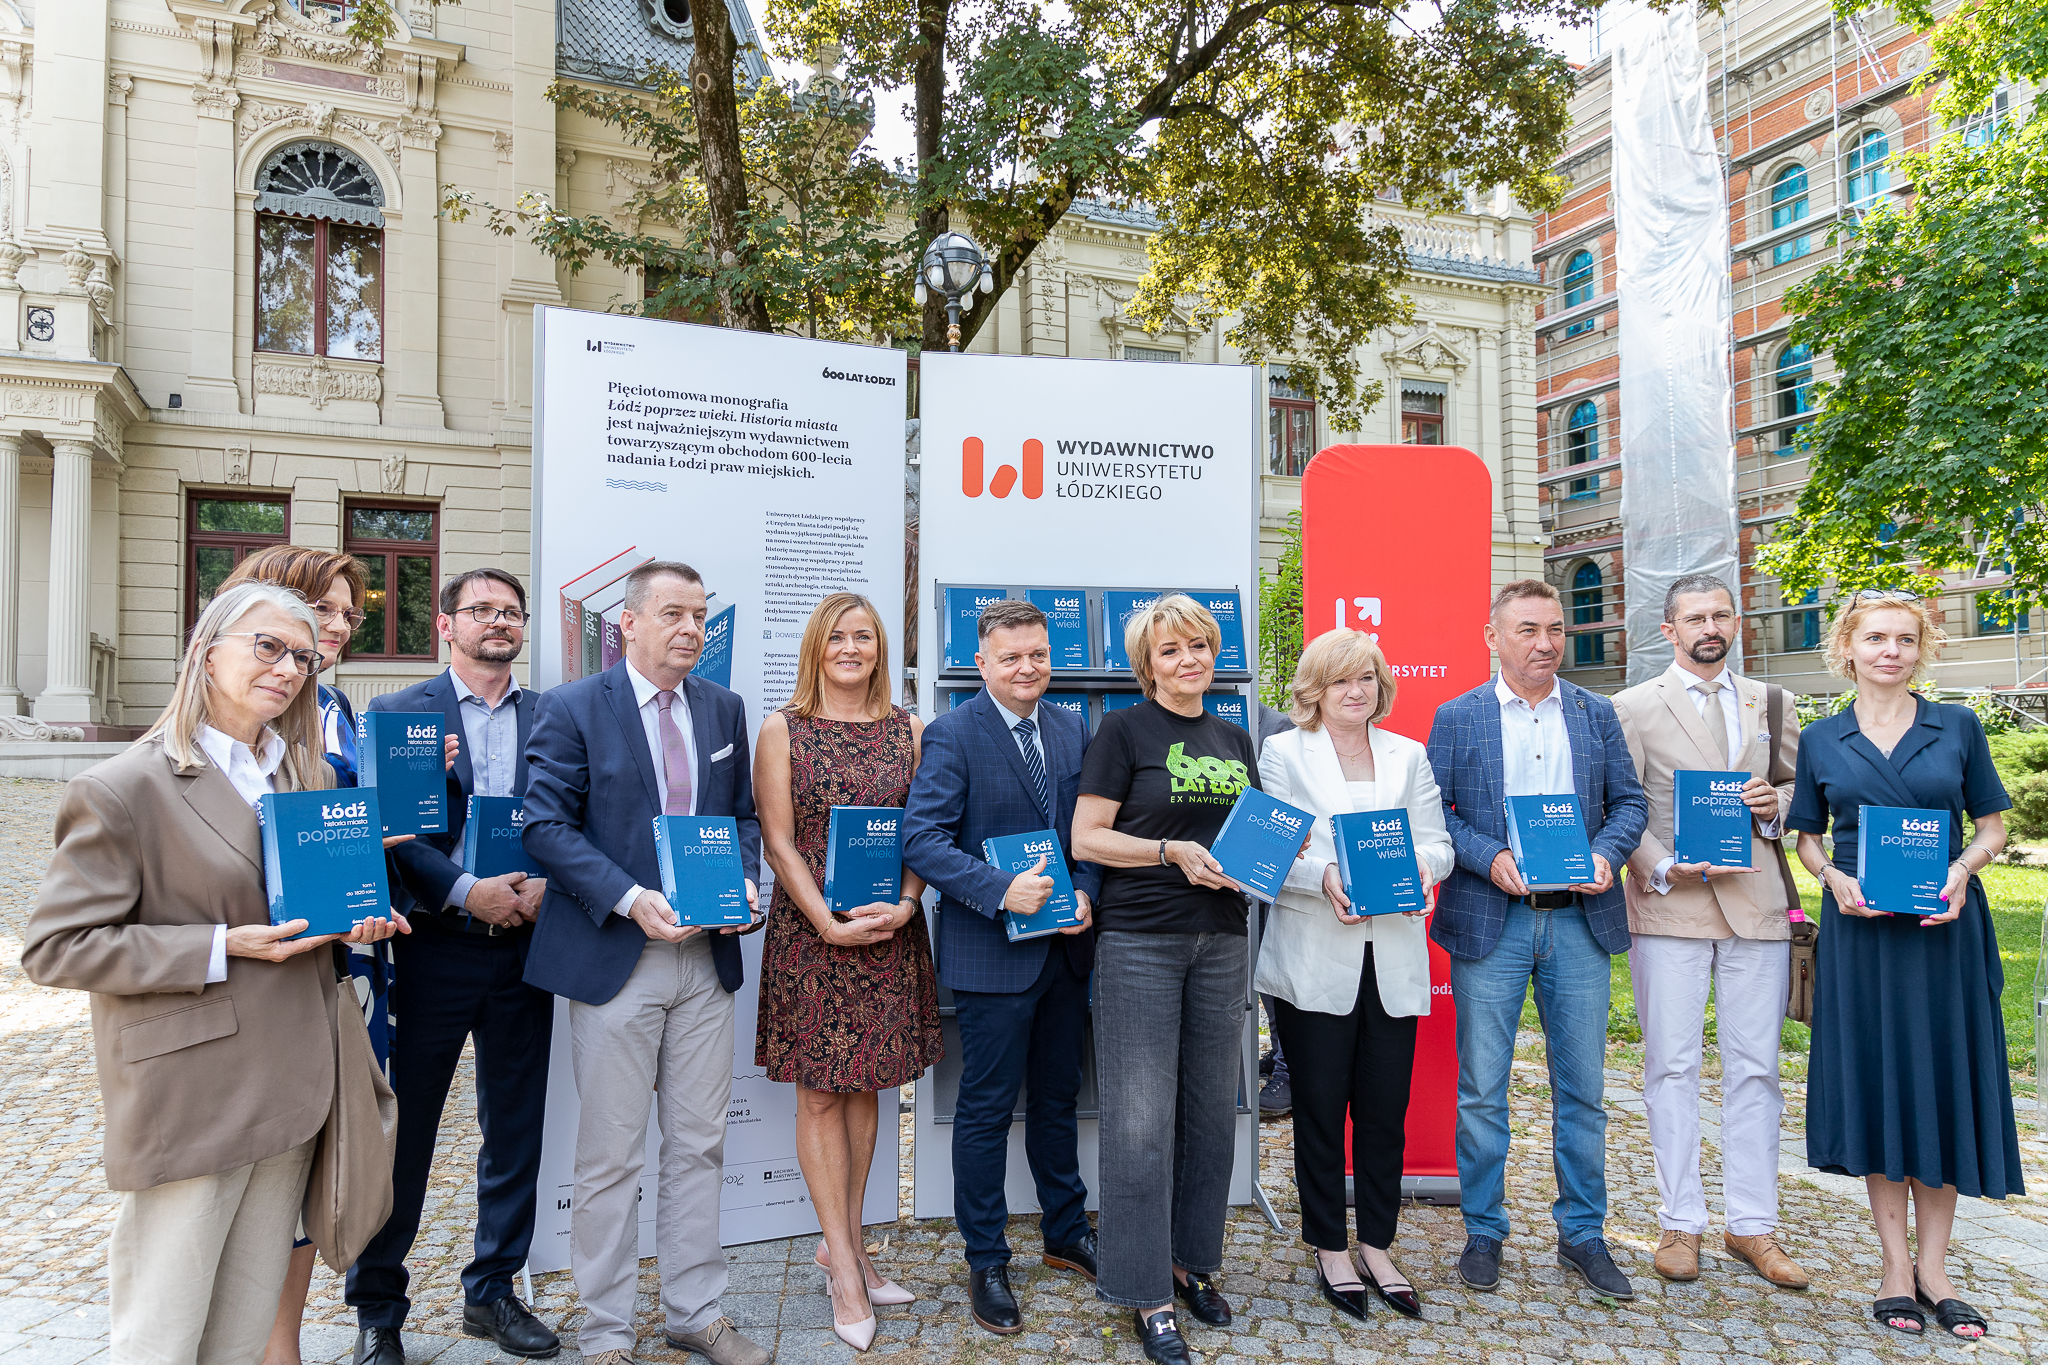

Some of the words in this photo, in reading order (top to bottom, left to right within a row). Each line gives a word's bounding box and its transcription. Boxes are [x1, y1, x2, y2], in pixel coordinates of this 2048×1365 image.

[822, 366, 845, 381] 600
[846, 372, 863, 383] LAT
[864, 375, 896, 386] ŁODZI
[607, 381, 707, 403] Pięciotomowa
[710, 394, 789, 411] monografia
[607, 399, 642, 413] Łódź
[643, 404, 697, 418] poprzez
[699, 409, 737, 422] wieki.
[740, 412, 793, 428] Historia
[795, 418, 838, 432] miasta
[606, 416, 633, 431] jest
[637, 420, 746, 441] najważniejszym
[749, 431, 849, 449] wydawnictwem
[607, 434, 715, 455] towarzyszącym
[718, 444, 788, 460] obchodom
[792, 450, 852, 466] 600-lecia
[1056, 440, 1214, 460] WYDAWNICTWO
[607, 453, 666, 467] nadania
[669, 456, 707, 470] Łodzi
[710, 461, 745, 475] praw
[747, 463, 815, 479] miejskich.
[1056, 461, 1203, 480] UNIWERSYTETU
[1056, 480, 1162, 500] ŁÓDZKIEGO
[766, 511, 800, 519] Uniwersytet
[765, 546, 788, 554] historię
[834, 550, 855, 558] Projekt
[765, 555, 799, 563] realizowany
[1054, 598, 1080, 607] Łódź
[1209, 600, 1234, 610] Łódź
[564, 598, 577, 625] ódź
[585, 610, 598, 637] ódź
[705, 615, 728, 642] ódź
[1055, 620, 1080, 628] wieki
[605, 621, 619, 649] ódź
[697, 650, 726, 677] wieki
[1387, 664, 1448, 678] RSYTET
[1217, 702, 1242, 712] Łódź
[406, 724, 437, 738] Łódź
[389, 746, 438, 759] poprzez
[408, 759, 437, 771] wieki
[1165, 741, 1251, 785] 600
[1170, 777, 1206, 793] LAT
[1209, 779, 1245, 796] ŁOD
[1709, 780, 1742, 792] Łódź
[1170, 795, 1183, 803] EX
[1692, 795, 1743, 807] poprzez
[321, 801, 368, 820] Łódź
[1542, 803, 1573, 813] Łódź
[1710, 806, 1742, 818] wieki
[324, 820, 346, 828] historia
[347, 818, 368, 826] miasta
[866, 819, 897, 831] Łódź
[1270, 808, 1302, 829] Łódź
[1371, 818, 1402, 832] Łódź
[1528, 818, 1577, 828] poprzez
[1247, 813, 1296, 841] poprzez
[1902, 819, 1939, 832] Łódź
[297, 826, 370, 847] poprzez
[491, 827, 522, 839] popr
[699, 826, 730, 839] Łódź
[1547, 828, 1578, 837] wieki
[848, 837, 896, 848] poprzez
[1023, 839, 1054, 853] Łódź
[1260, 830, 1290, 850] wieki
[1357, 836, 1406, 851] poprzez
[1881, 835, 1939, 848] poprzez
[326, 841, 371, 857] wieki
[684, 845, 733, 856] poprzez
[865, 848, 895, 858] wieki
[1376, 847, 1407, 859] wieki
[1902, 849, 1938, 860] wieki
[704, 856, 734, 868] wieki
[745, 1108, 751, 1116] 3
